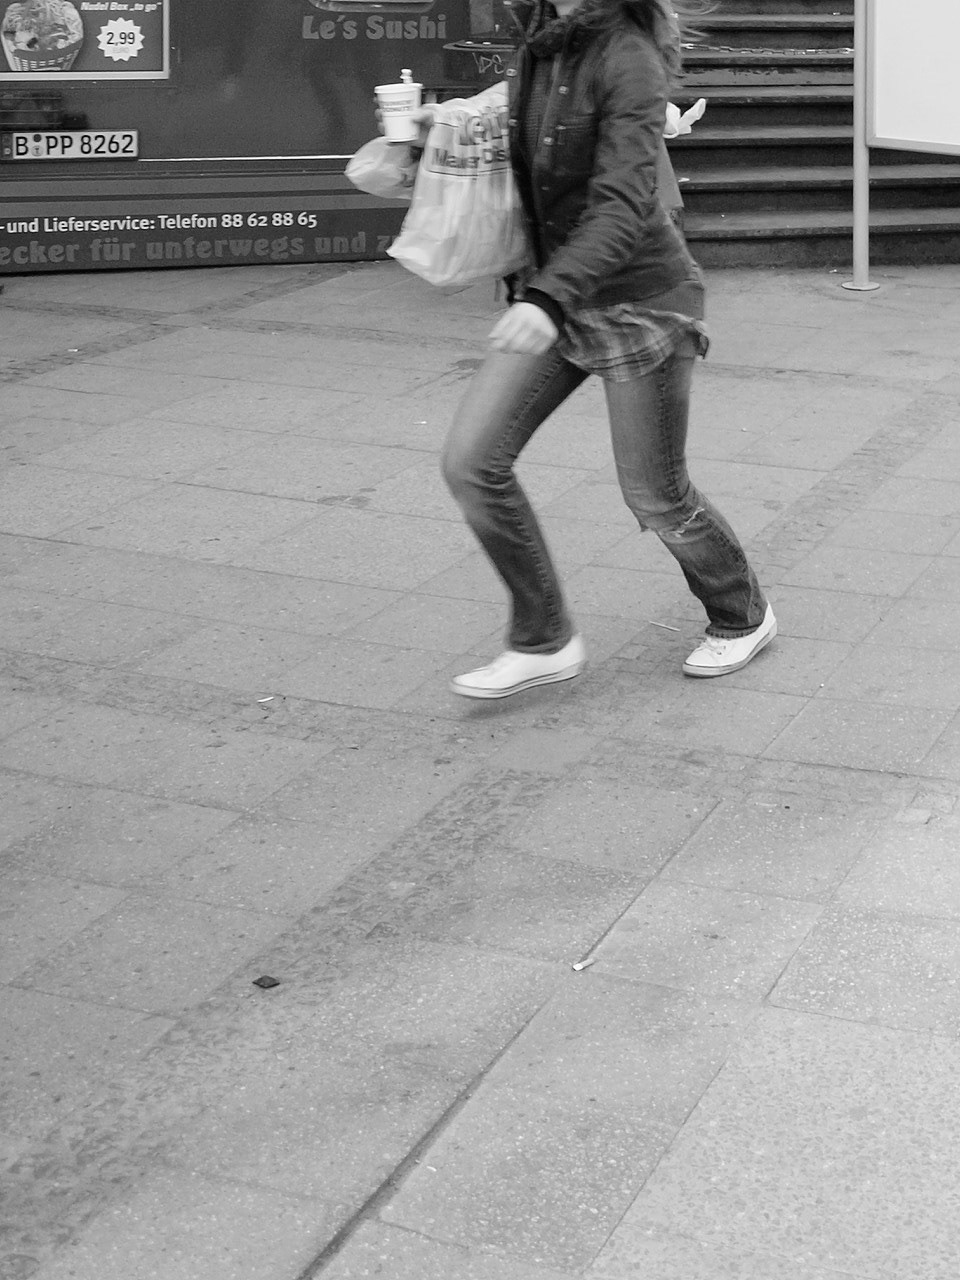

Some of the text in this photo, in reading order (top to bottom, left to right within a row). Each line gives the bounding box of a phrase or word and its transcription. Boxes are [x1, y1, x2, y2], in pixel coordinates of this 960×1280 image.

[110, 2, 128, 11] Box
[302, 14, 447, 40] Le's Sushi
[106, 32, 135, 46] 2,99
[15, 134, 134, 156] B PP 8262
[44, 215, 155, 232] Lieferservice:
[157, 213, 217, 230] Telefon
[221, 214, 243, 228] 88
[247, 213, 268, 227] 62
[272, 212, 293, 226] 88
[297, 212, 317, 228] 65
[90, 237, 136, 261] für
[146, 235, 304, 261] unterwegs
[314, 231, 366, 255] und
